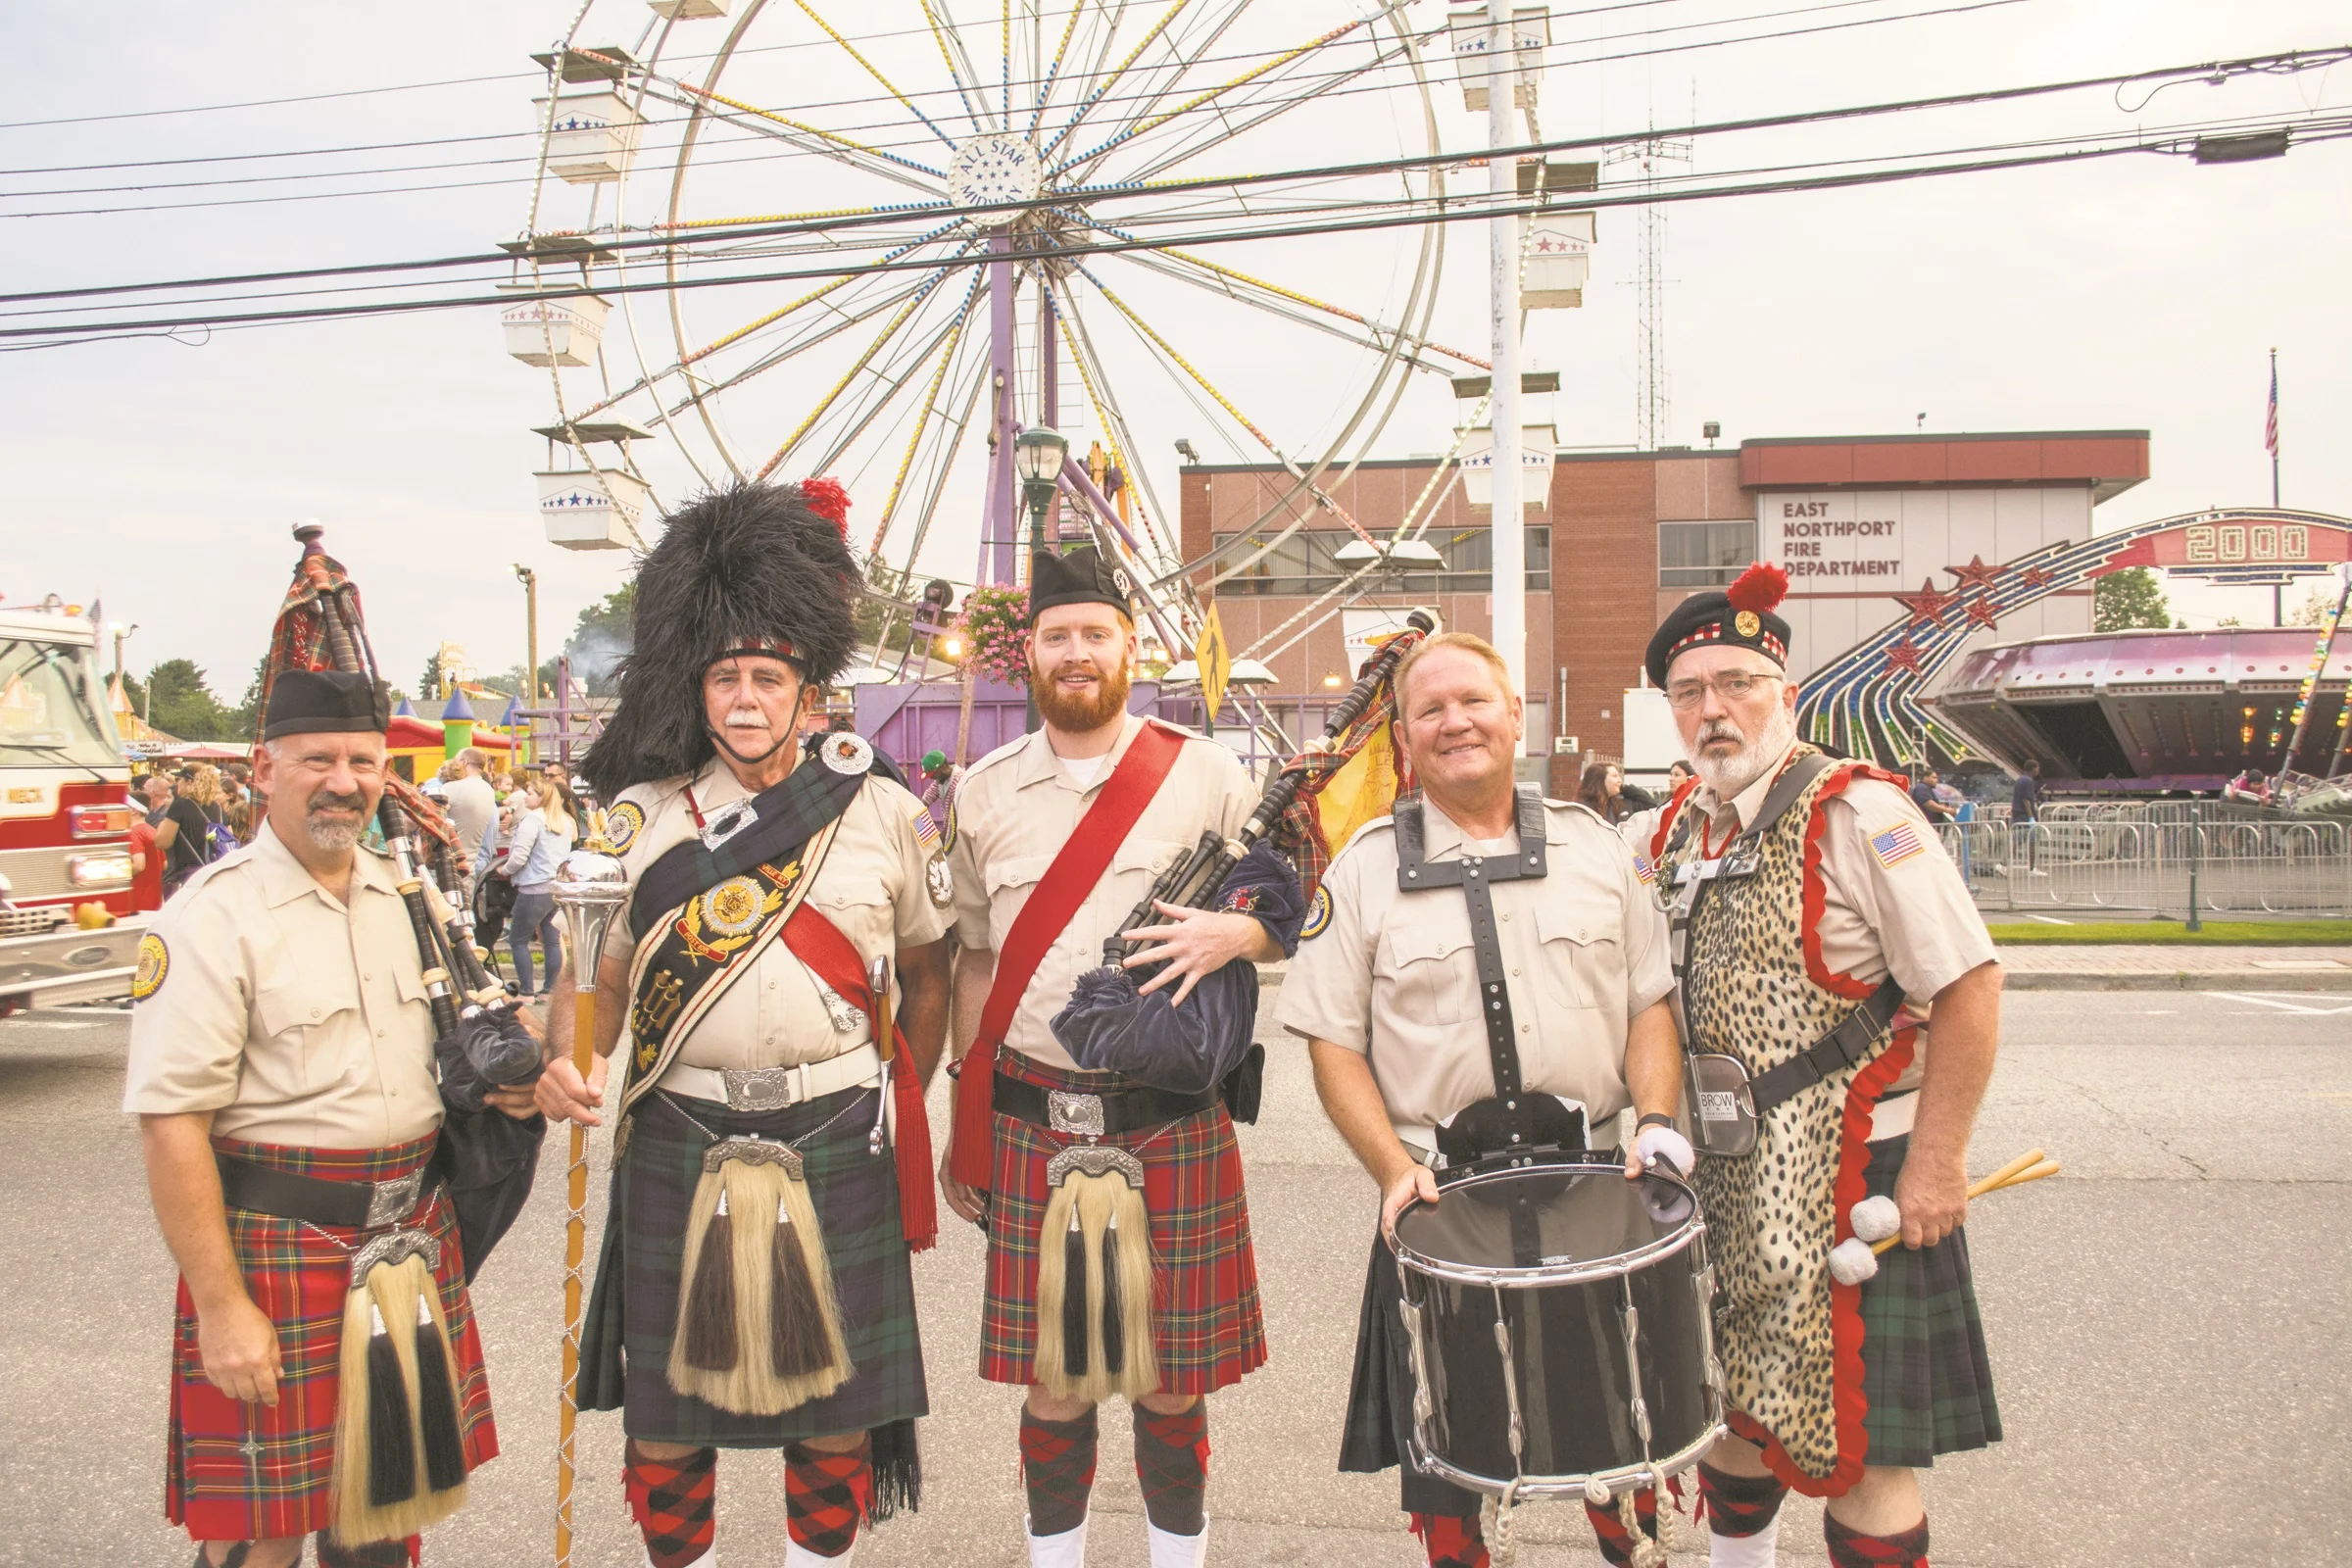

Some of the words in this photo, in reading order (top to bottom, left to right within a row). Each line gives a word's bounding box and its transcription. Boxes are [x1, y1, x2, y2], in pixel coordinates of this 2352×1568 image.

[959, 145, 985, 174] ALL
[991, 139, 1025, 168] STAR
[1784, 502, 1829, 517] EAST
[1784, 520, 1895, 537] NORTHPORT
[1784, 542, 1821, 557] FIRE
[2185, 524, 2308, 562] 2000
[1784, 561, 1900, 576] DEPARTMENT
[727, 898, 741, 910] US
[684, 931, 700, 947] POST
